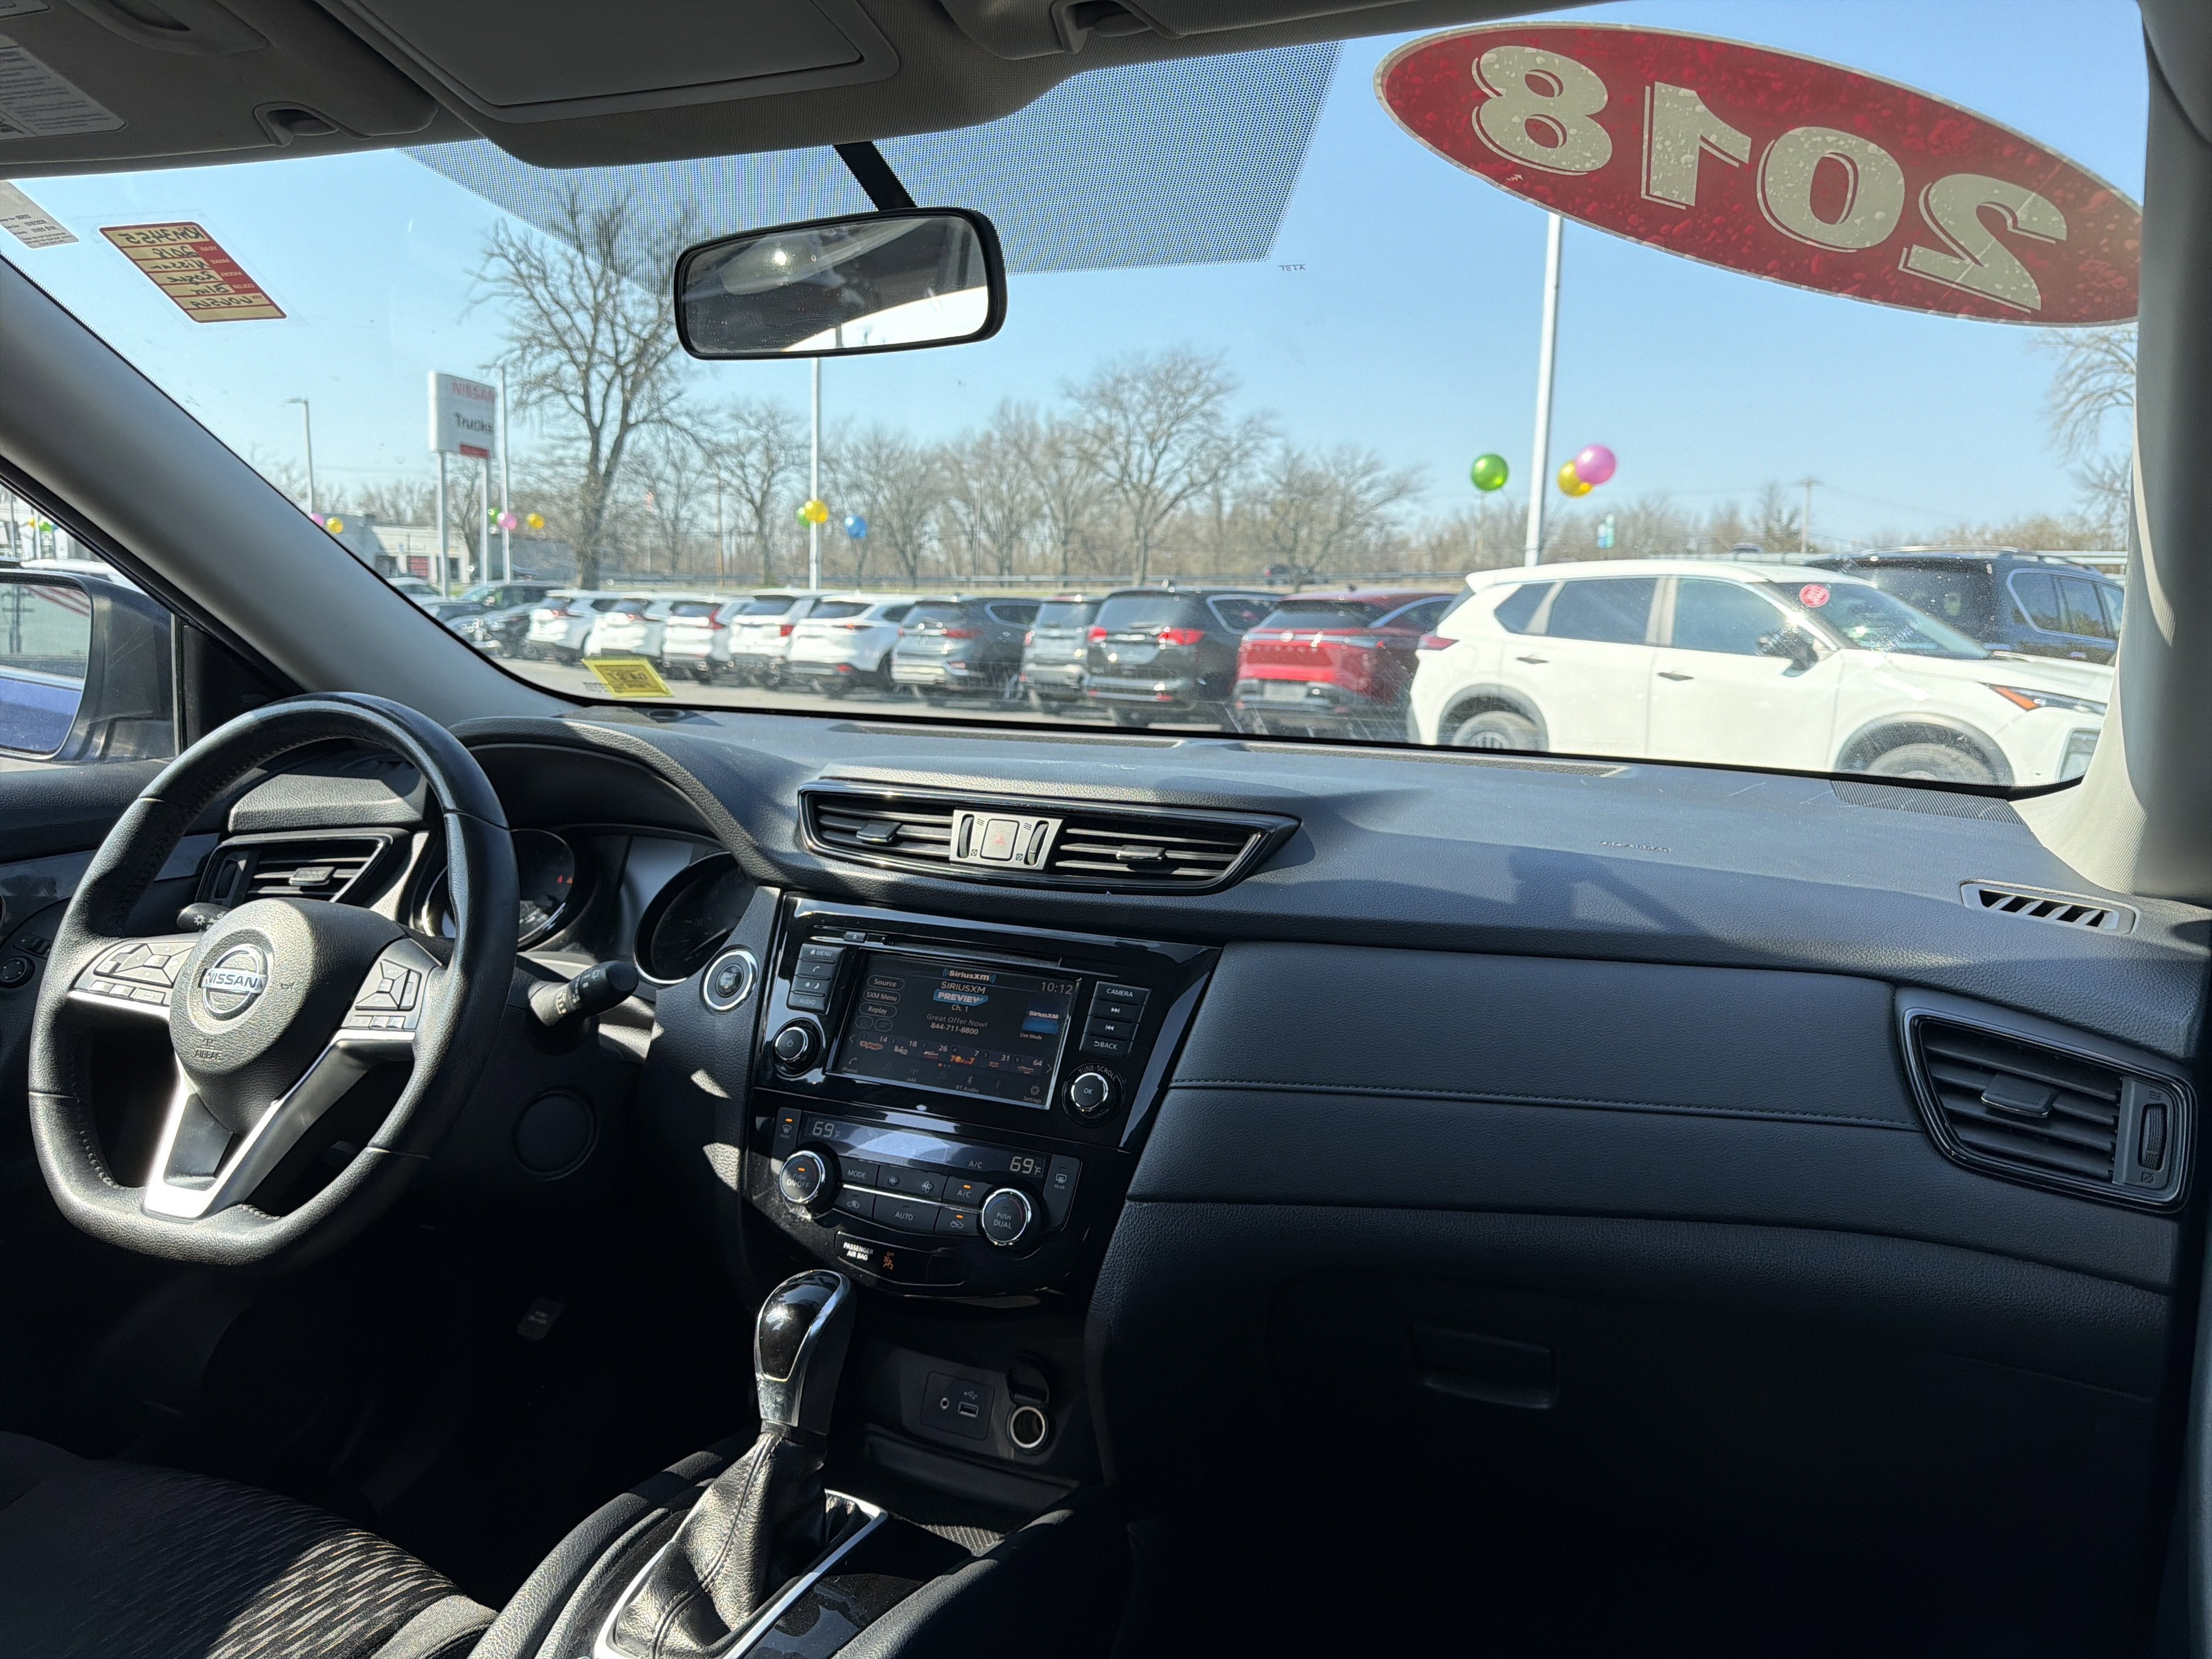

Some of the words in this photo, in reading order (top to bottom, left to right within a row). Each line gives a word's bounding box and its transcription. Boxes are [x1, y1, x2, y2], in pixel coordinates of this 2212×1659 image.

[206, 972, 259, 990] NISSAN
[874, 978, 897, 987] Source
[941, 981, 986, 994] SIRIUSXM
[1041, 981, 1073, 994] 10:12
[1107, 988, 1133, 997] CAMERA
[938, 991, 984, 1003] PREVIEW
[868, 1006, 888, 1015] Replay
[927, 1014, 946, 1022] Great
[947, 1016, 967, 1025] Offer
[968, 1019, 988, 1028] Now!
[930, 1023, 979, 1035] 844-711-8800
[1101, 1042, 1118, 1050] BACK
[969, 1160, 983, 1169] A/C
[848, 1170, 866, 1178] MODE
[957, 1189, 971, 1198] A/C
[895, 1211, 913, 1221] AUTO
[994, 1219, 1012, 1229] DUAL
[843, 1242, 873, 1255] PASSENGER
[847, 1250, 856, 1258] AIR
[857, 1252, 868, 1261] BAG
